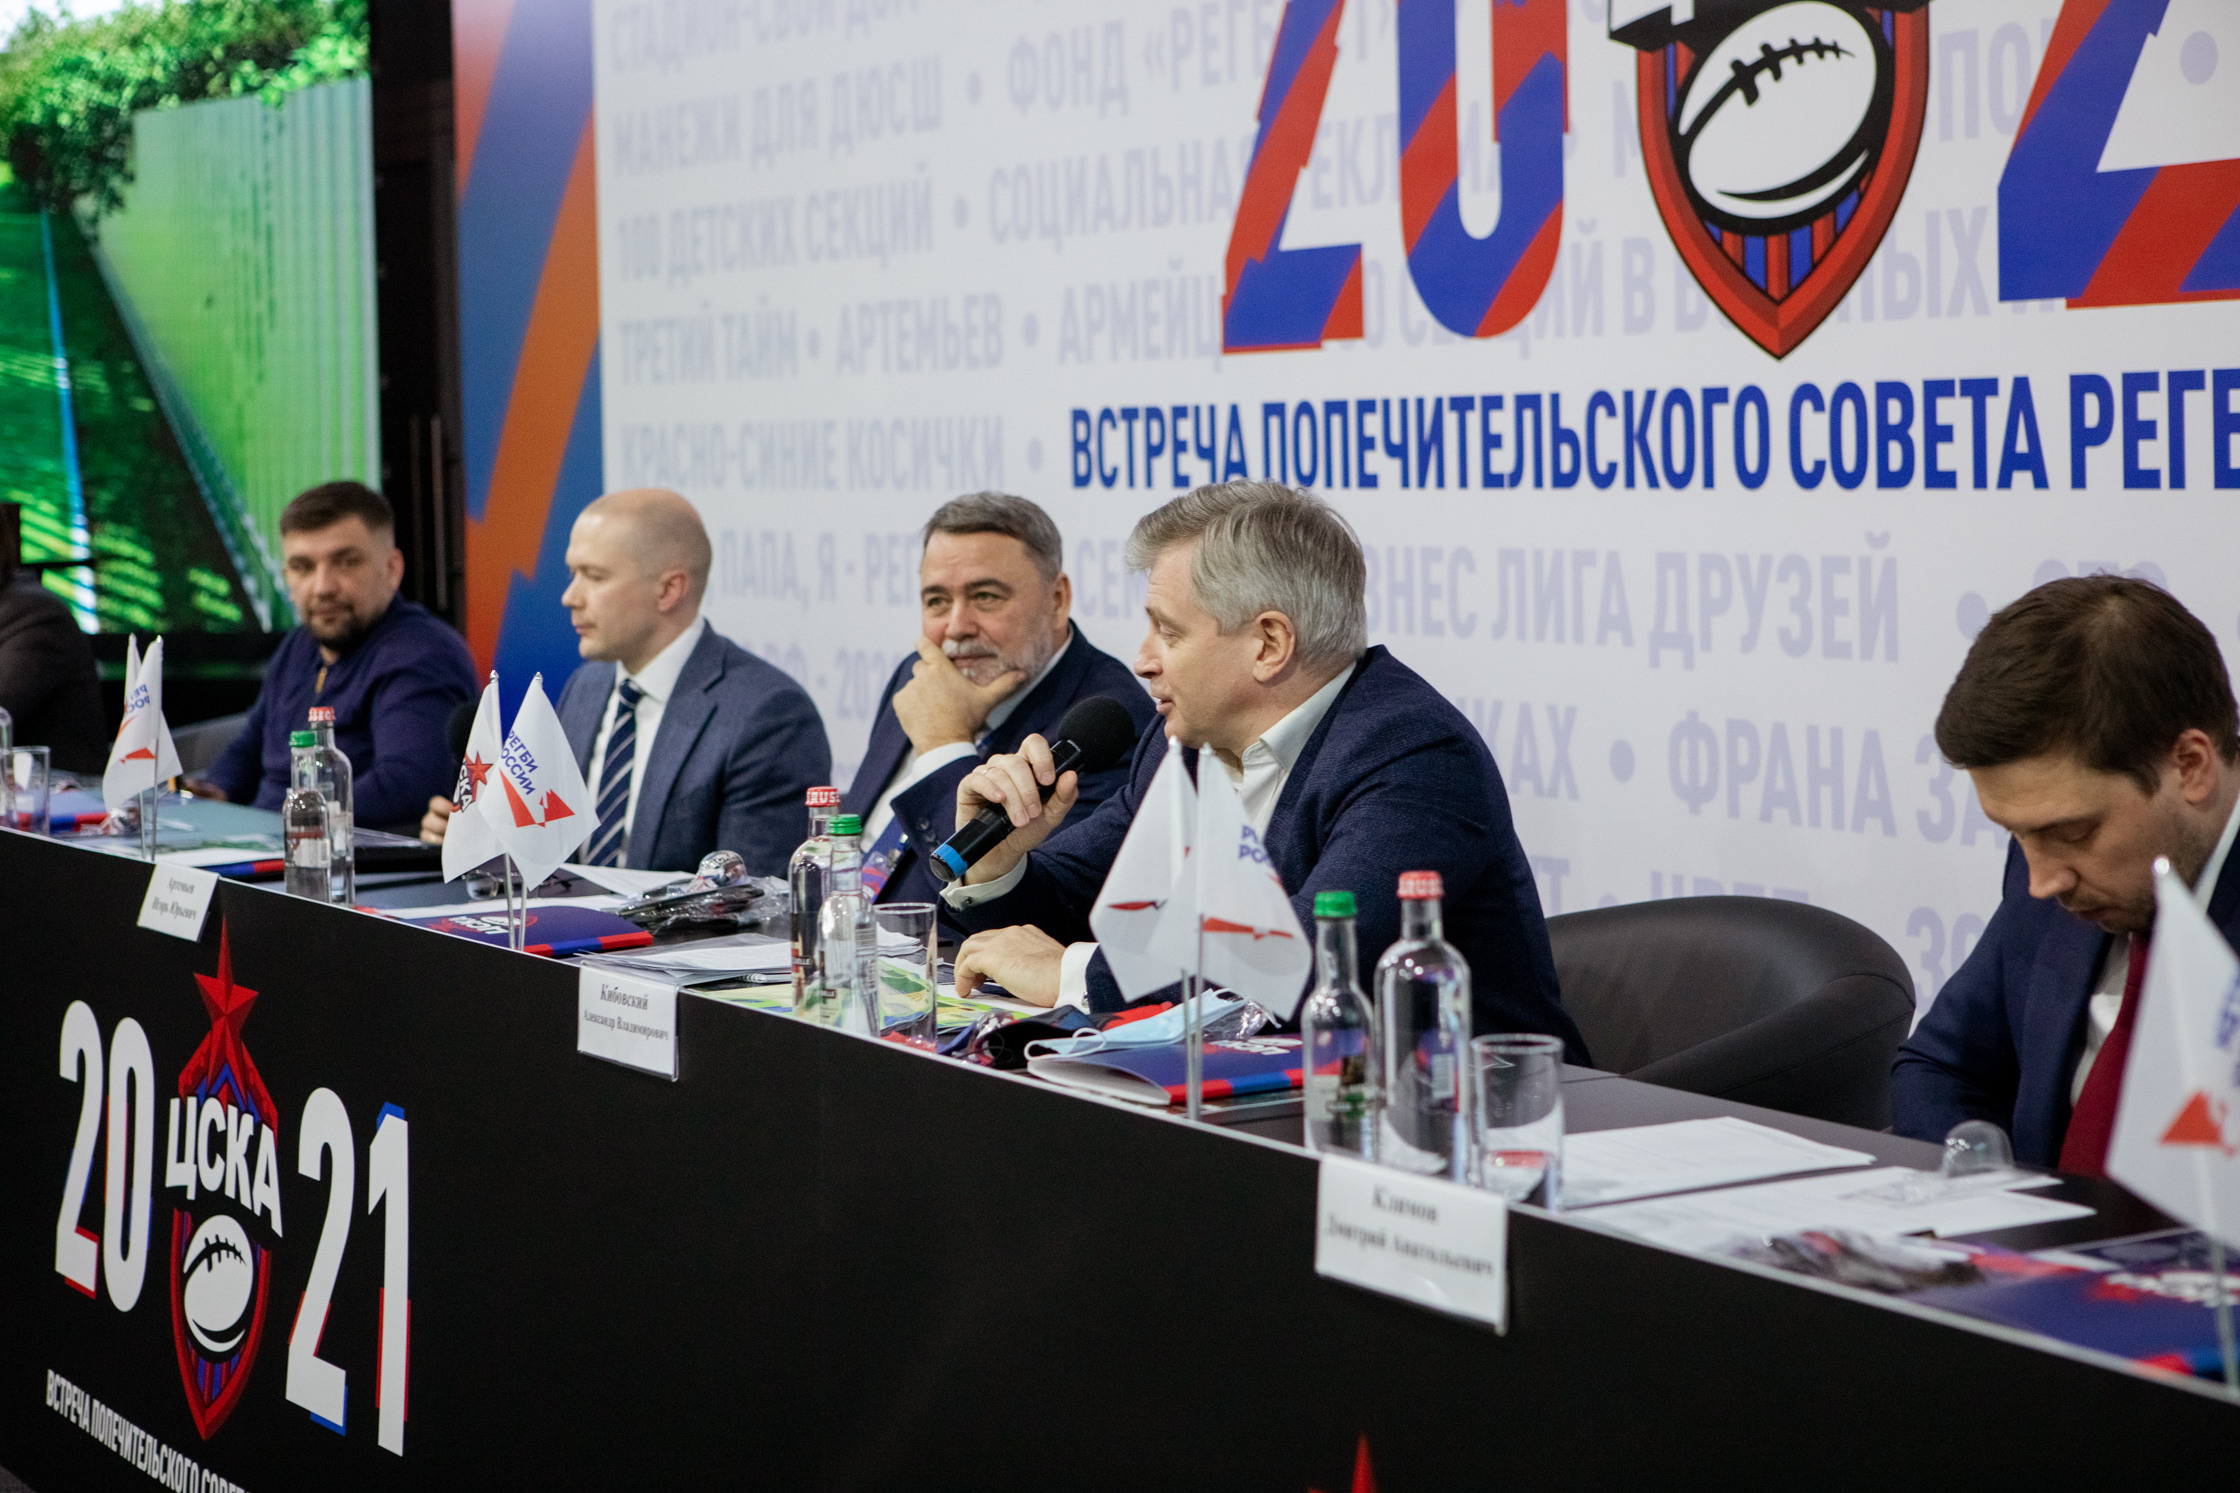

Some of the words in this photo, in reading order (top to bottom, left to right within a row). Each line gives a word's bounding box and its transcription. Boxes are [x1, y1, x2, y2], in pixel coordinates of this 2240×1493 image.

[753, 76, 820, 172] ДЛЯ
[827, 54, 943, 161] ДЮСШ
[1007, 18, 1130, 120] ФОНД
[805, 160, 935, 272] СЕКЦИЙ
[988, 133, 1252, 254] СОЦИАЛЬНА
[835, 291, 1005, 377] АРТЕМЬЕВ
[1057, 256, 1223, 374] АРМЕЙЦ
[620, 418, 837, 491] КРАСНО-СИНИЕ
[846, 415, 1005, 491] КОСИЧКИ
[1071, 403, 1250, 489] ВСТРЕЧА
[1262, 384, 1771, 489] ПОПЕЧИТЕЛЬСКОГО
[1788, 376, 2050, 489] СОВЕТА
[1491, 546, 1636, 649] ЛИГА
[1648, 529, 1900, 672] ДРУЗЕЙ
[500, 747, 537, 796] ОССИИ
[1667, 710, 1898, 838] ФРАНА
[600, 983, 649, 1011] Кибовский
[616, 1016, 669, 1041] Владимирович
[55, 1000, 156, 1313] 20
[165, 1095, 283, 1238] ЦСКА
[285, 1086, 411, 1458] 21
[45, 1367, 91, 1434] ВСТРЕЧА
[91, 1397, 201, 1493] ПОПЕЧИТЕЛЬСКОГО
